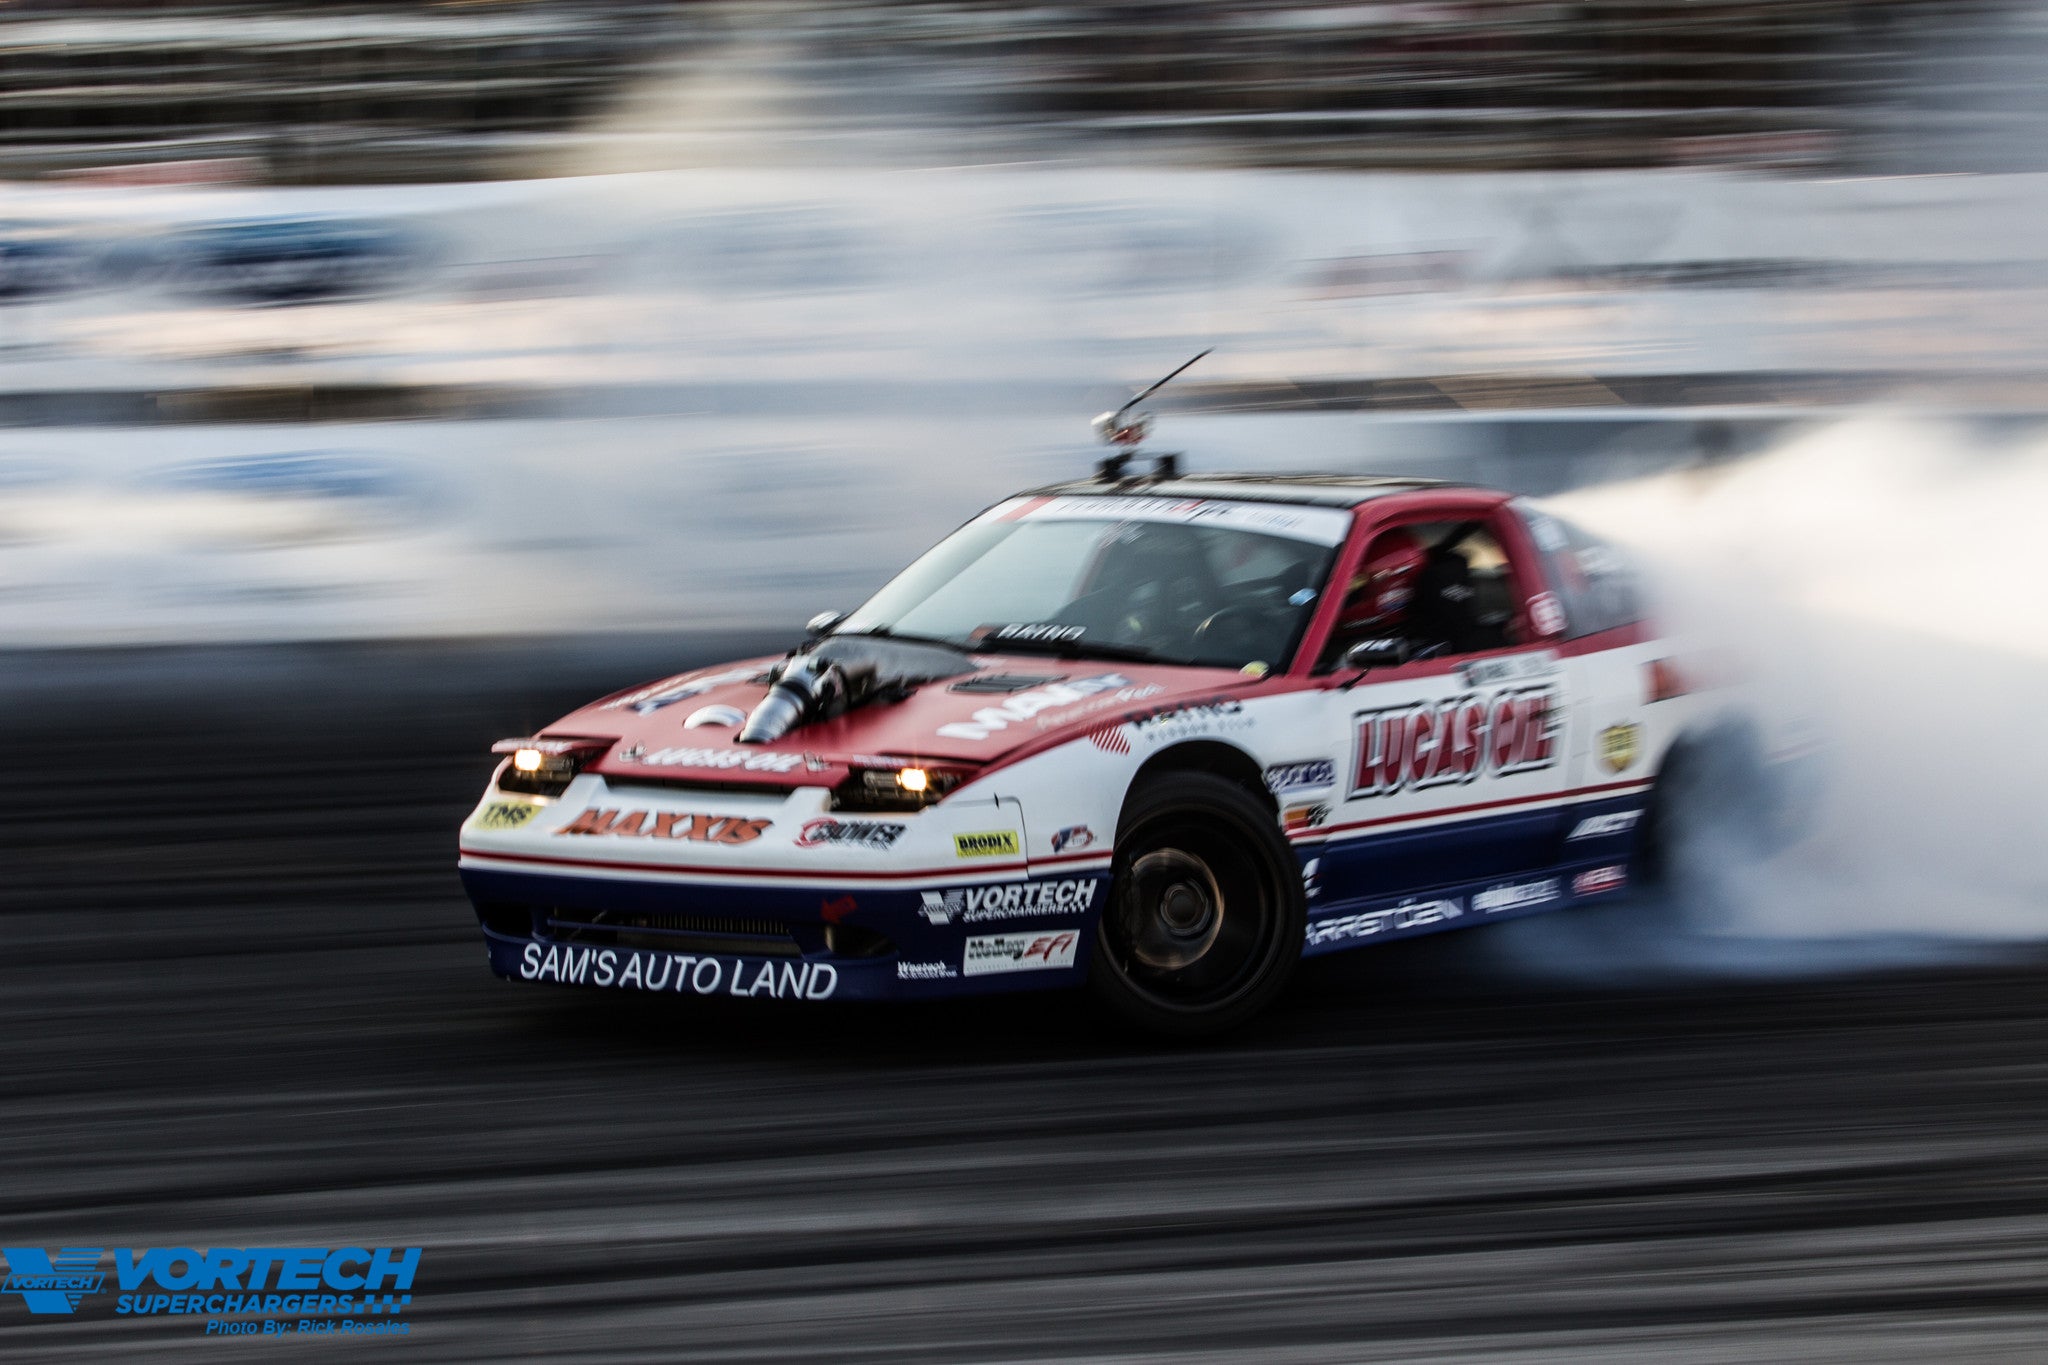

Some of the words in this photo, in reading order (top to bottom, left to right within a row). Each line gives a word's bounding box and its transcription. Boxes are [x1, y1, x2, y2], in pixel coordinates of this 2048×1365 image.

[1345, 690, 1486, 804] LUCAS
[553, 808, 774, 844] MAXXIS
[957, 833, 1014, 851] BRODIX
[966, 878, 1098, 912] VORTECH
[520, 943, 618, 986] SAM'S
[618, 952, 722, 994] AUTO
[729, 958, 838, 1000] LAND
